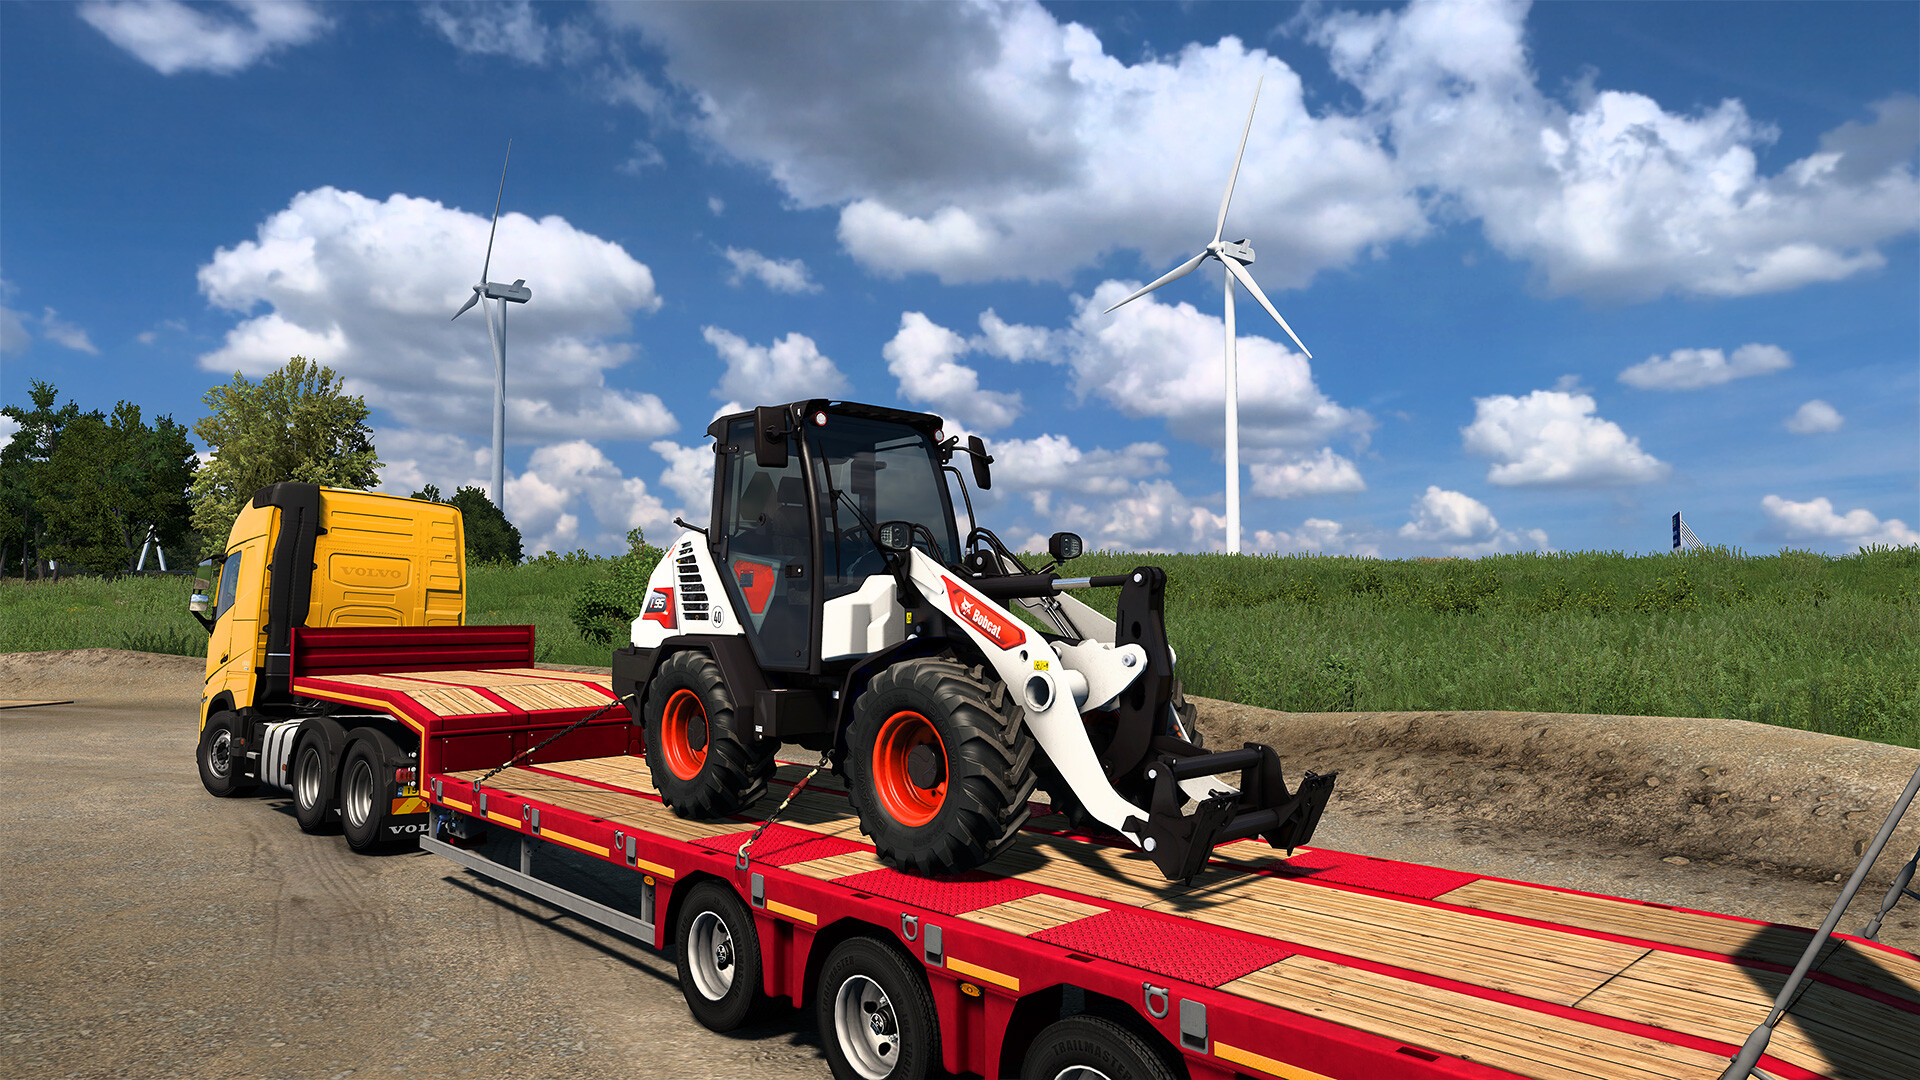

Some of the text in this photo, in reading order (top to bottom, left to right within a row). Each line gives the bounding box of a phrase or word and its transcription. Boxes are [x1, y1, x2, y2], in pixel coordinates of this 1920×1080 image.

[340, 566, 401, 579] VOLVO
[713, 611, 722, 624] 40
[972, 609, 1001, 638] Bobcat
[388, 823, 430, 835] VOL
